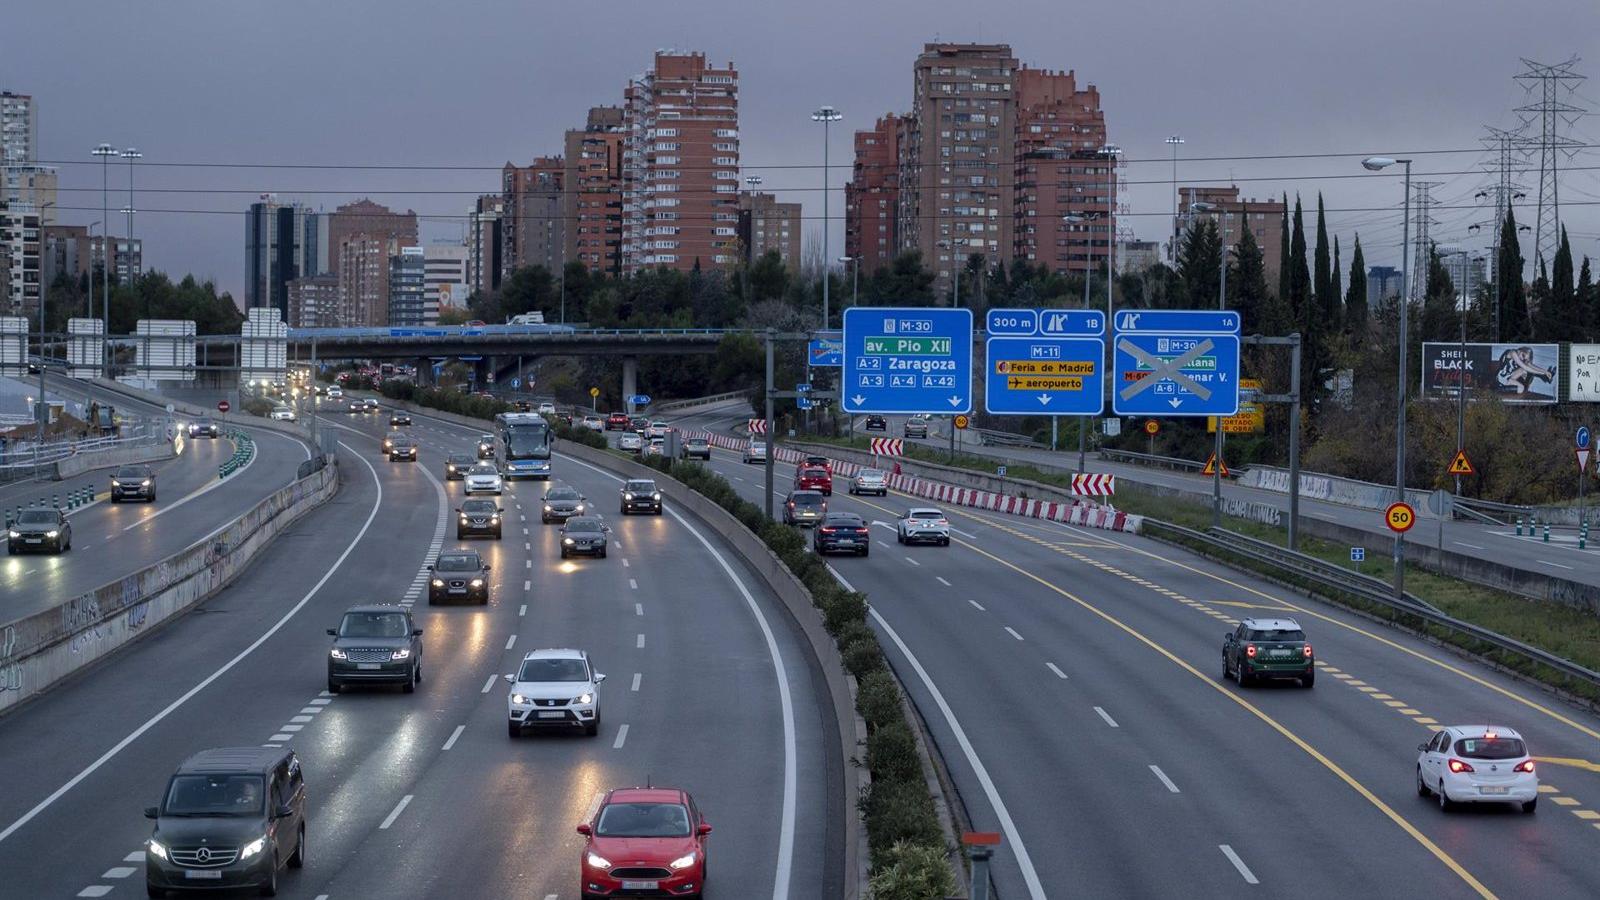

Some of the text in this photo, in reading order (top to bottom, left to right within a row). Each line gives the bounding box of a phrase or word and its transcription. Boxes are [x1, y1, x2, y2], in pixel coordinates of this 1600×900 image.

[901, 321, 931, 331] M-30
[994, 318, 1017, 327] 300
[1085, 319, 1098, 328] 1B
[1223, 319, 1233, 327] 1A
[866, 340, 950, 353] av. Pio XII
[1033, 347, 1058, 357] M-11
[858, 357, 956, 372] A-2 Zaragoza
[1011, 364, 1094, 373] Feria de Madrid
[1434, 360, 1474, 370] BLACK
[861, 376, 954, 386] A-3 A-4 A-42
[1218, 373, 1228, 382] V.
[1026, 379, 1082, 389] aeropuerto
[1577, 382, 1583, 392] A
[1392, 512, 1408, 523] 50
